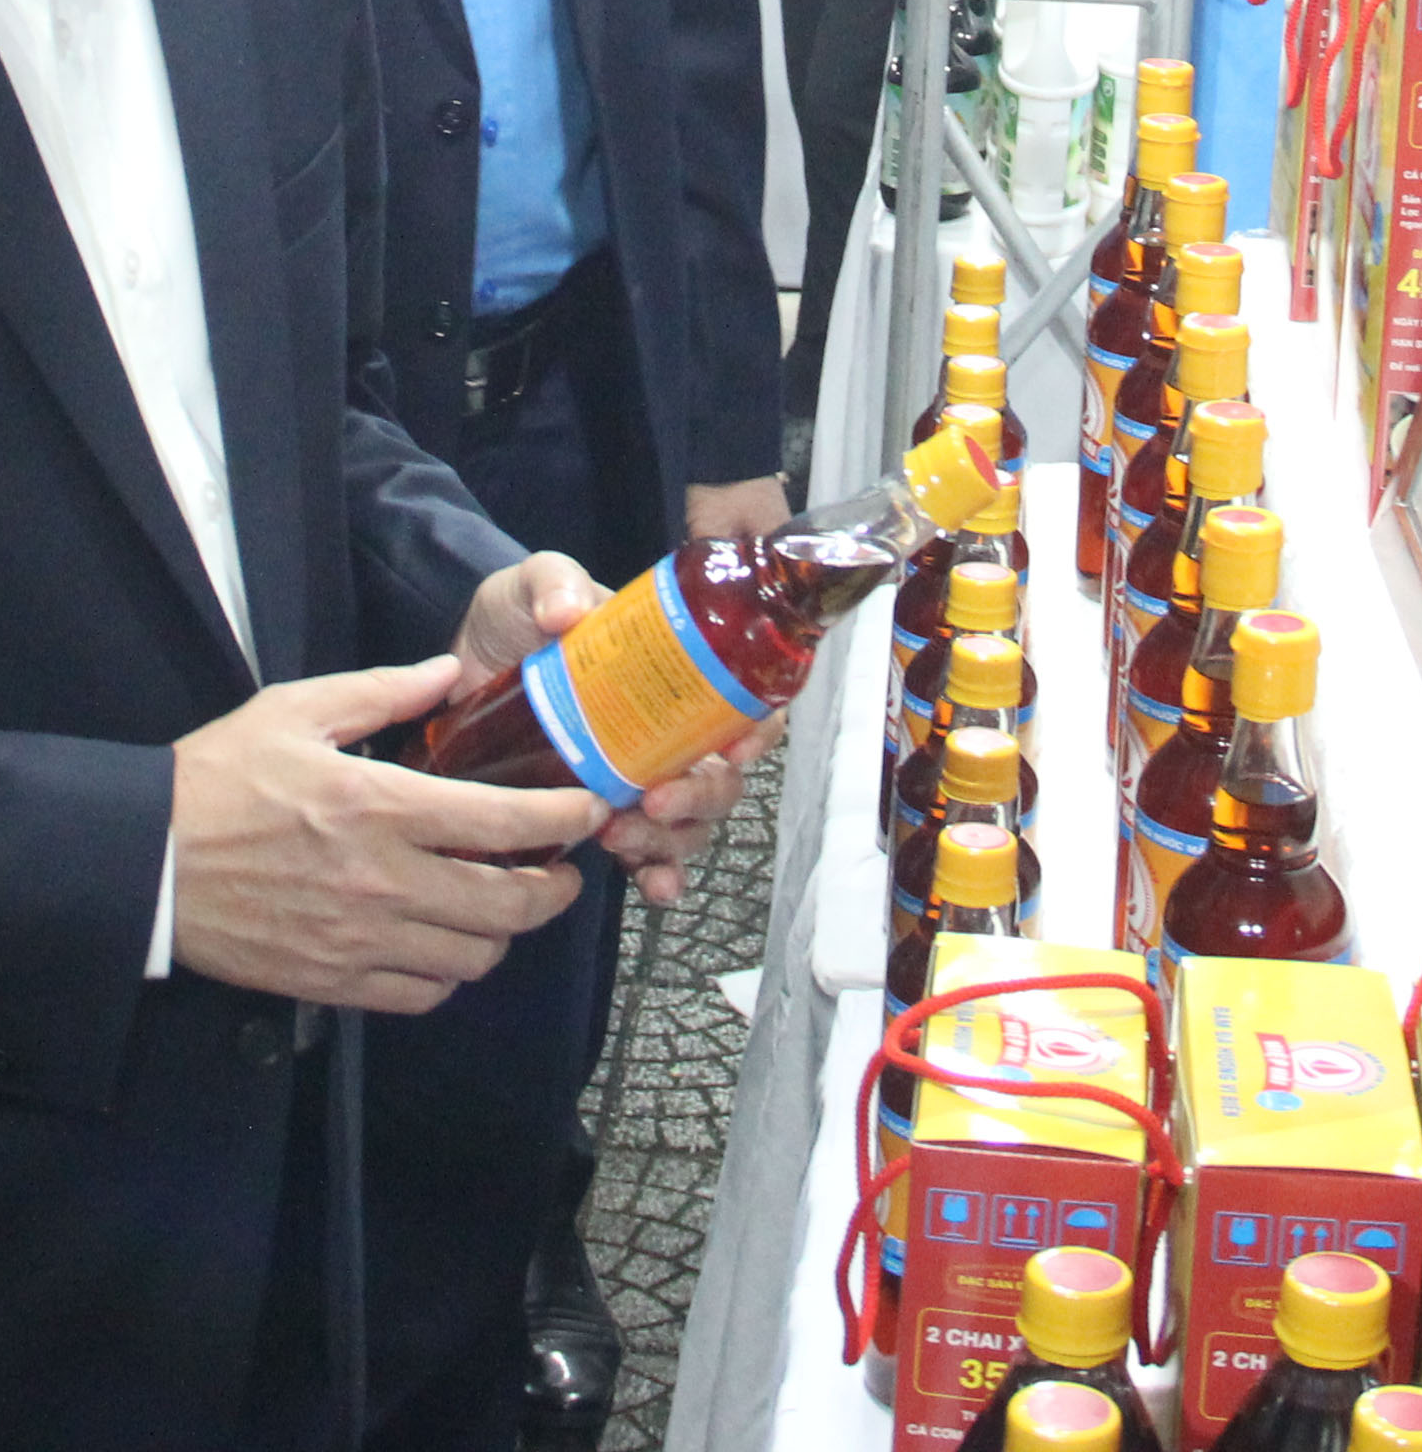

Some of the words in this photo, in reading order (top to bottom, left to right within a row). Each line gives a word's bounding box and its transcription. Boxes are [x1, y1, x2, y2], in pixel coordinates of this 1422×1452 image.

[1396, 268, 1421, 299] 4
[925, 1326, 942, 1344] 2
[945, 1328, 1003, 1350] CHAI
[959, 1358, 1009, 1390] 35
[1211, 1350, 1228, 1368] 2
[1231, 1351, 1268, 1371] CH
